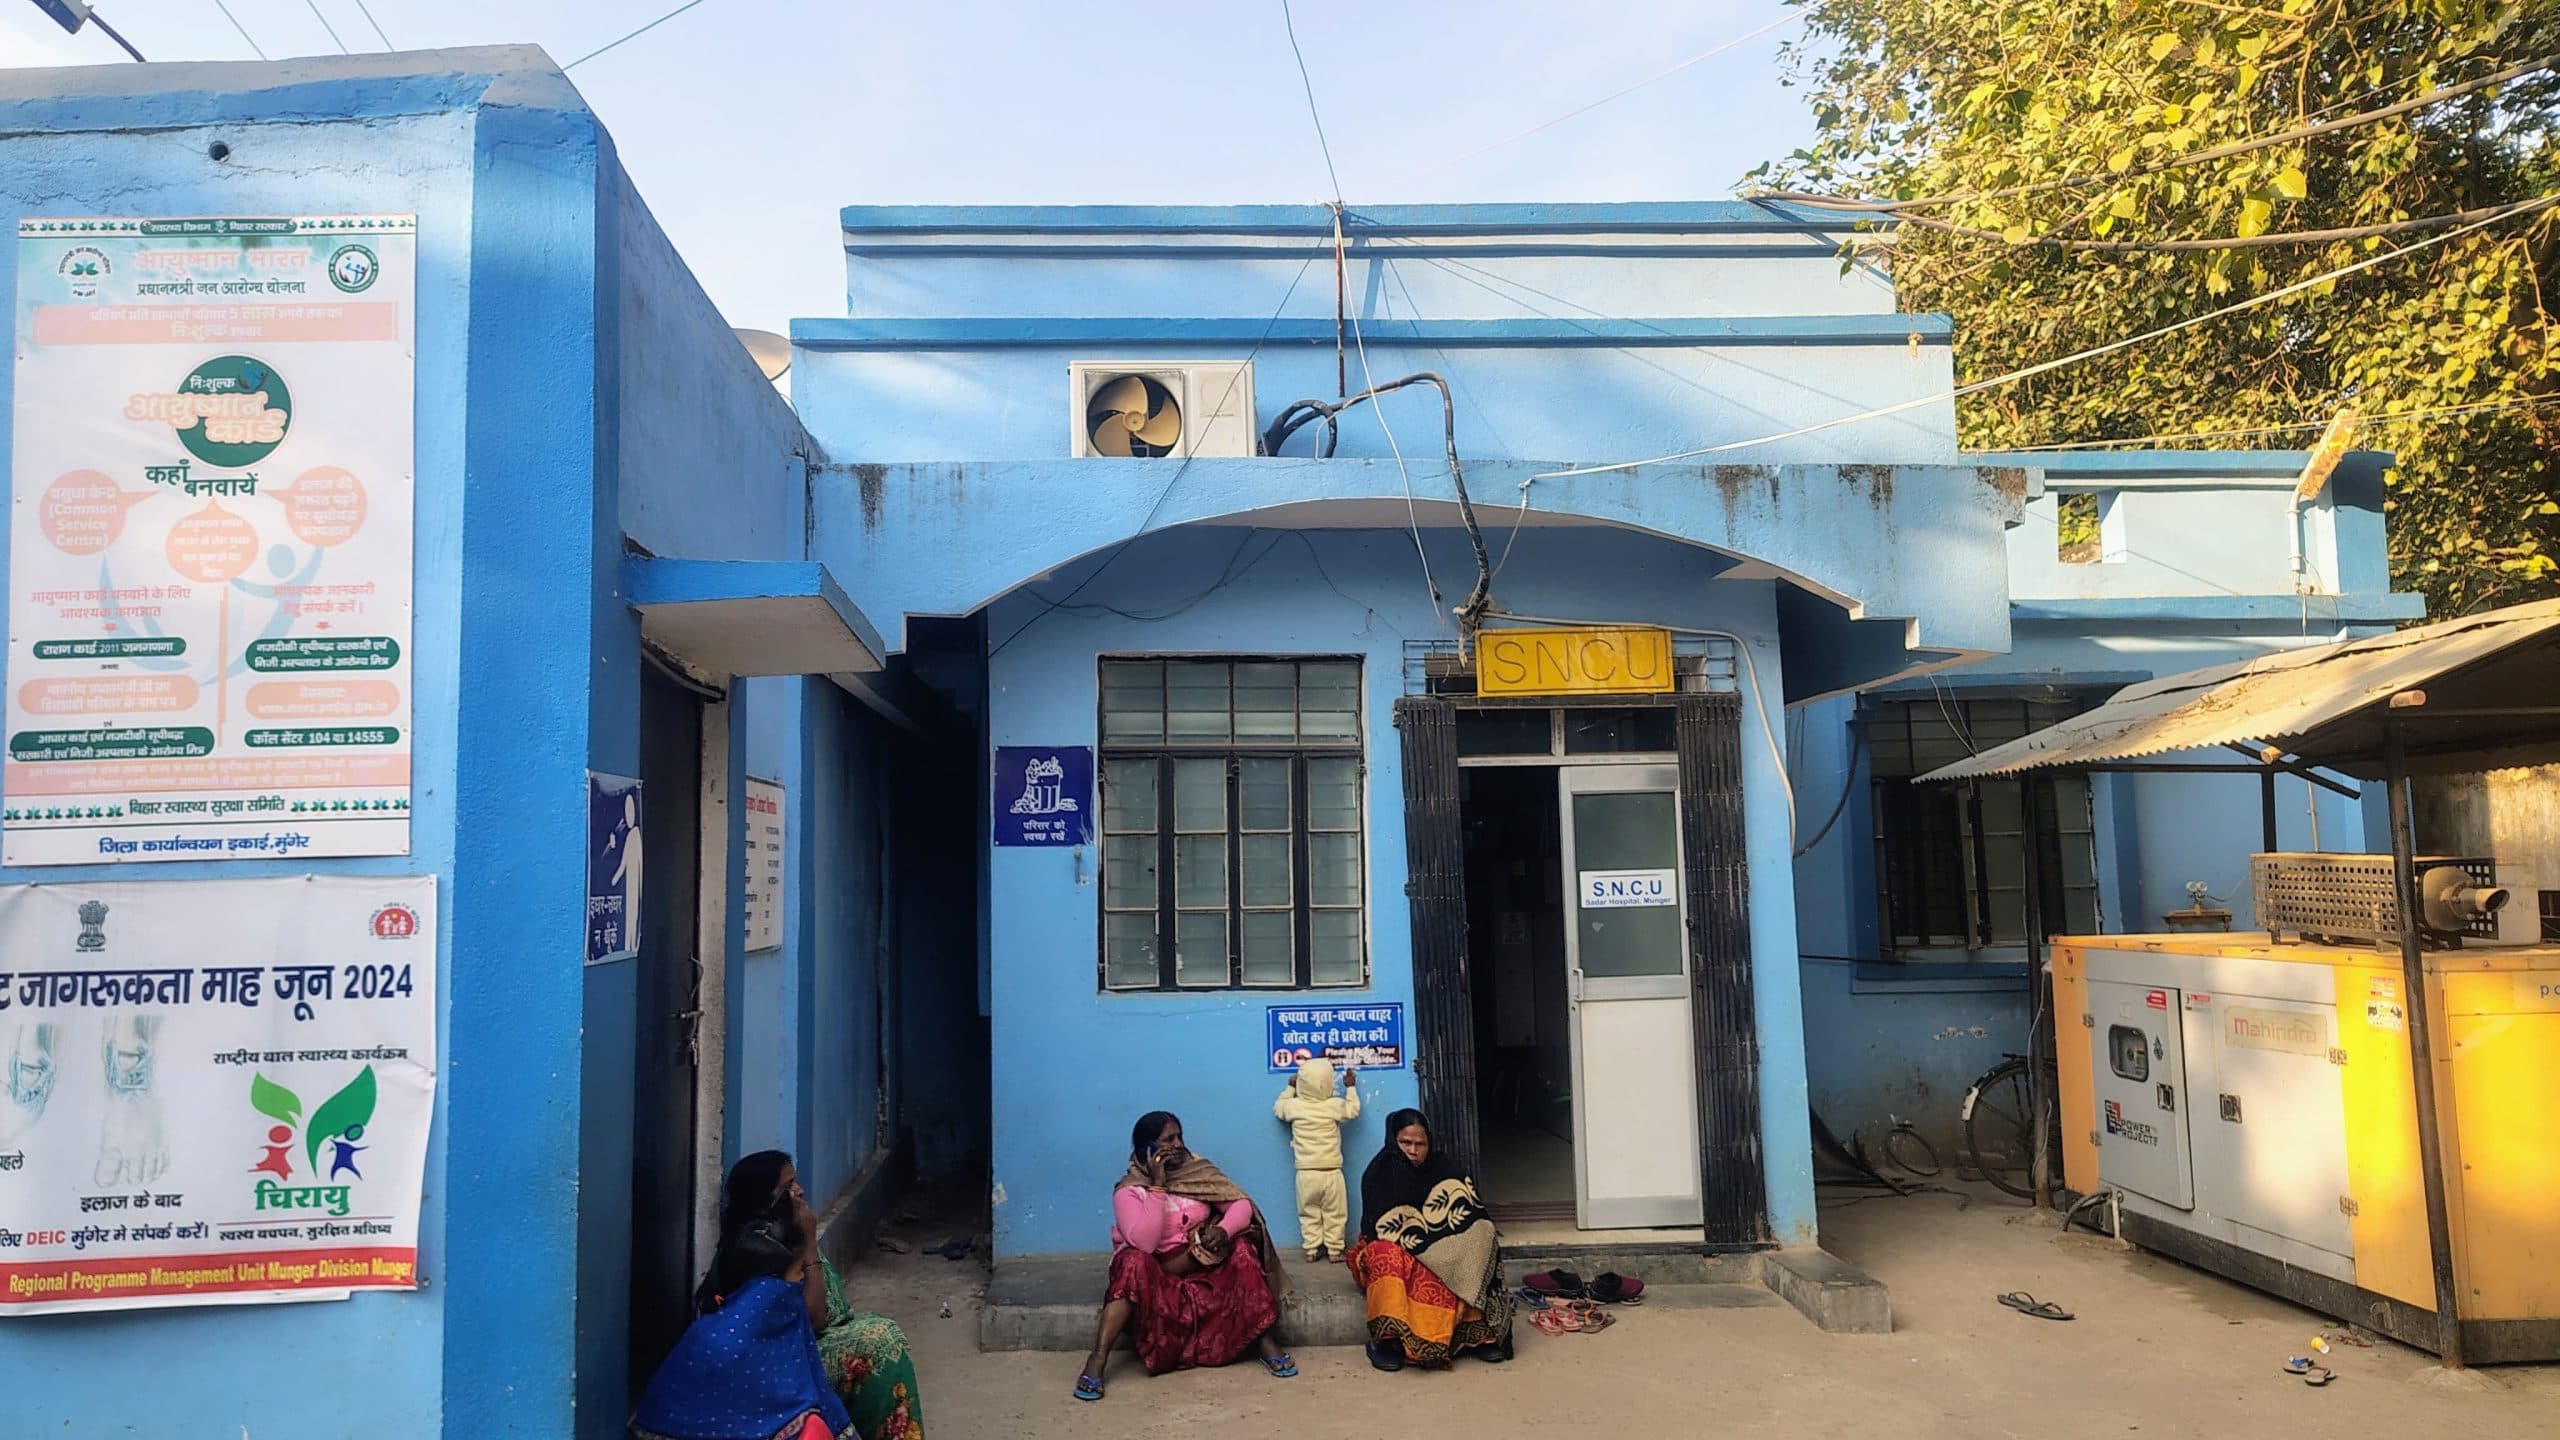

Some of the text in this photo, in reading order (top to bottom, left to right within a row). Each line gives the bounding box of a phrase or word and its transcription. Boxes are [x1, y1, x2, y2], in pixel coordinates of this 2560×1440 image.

[138, 247, 238, 275] आयुष्मान
[248, 246, 310, 269] भारत
[137, 278, 305, 297] प्रधानमंत्री जन आरोग्य योजना
[126, 392, 267, 427] आयुष्मान
[206, 408, 285, 442] कार्ड
[145, 459, 190, 485] कहाँ
[184, 474, 259, 497] बनवायें
[49, 504, 117, 518] (Common
[56, 518, 108, 530] Service
[32, 591, 79, 607] आयुष्मान
[84, 587, 109, 601] कार्ड
[152, 585, 164, 600] के
[167, 584, 192, 600] लिए
[60, 605, 112, 619] आवश्यक
[43, 641, 71, 656] राशन
[74, 638, 98, 654] कार्ड
[100, 642, 119, 654] 2011
[1493, 636, 1658, 685] SNCU
[38, 733, 66, 745] आधार
[253, 730, 278, 745] कॉल
[281, 729, 304, 743] सेंटर
[309, 732, 330, 744] 104
[348, 731, 384, 744] 14555
[17, 748, 52, 760] सरकारी
[69, 746, 94, 758] निजी
[129, 795, 285, 817] बिहार स्वास्थ्य सुरक्षा समिति
[1023, 818, 1066, 831] परिसर को
[99, 837, 138, 854] जिला
[142, 834, 222, 852] कार्यान्वयन
[1592, 879, 1662, 897] S.N.C.U
[1585, 898, 1607, 906] Sadar
[1643, 897, 1671, 905] Munger
[18, 967, 194, 1008] जागरूकता
[201, 966, 264, 1007] माह
[274, 965, 335, 1021] जून
[344, 964, 413, 1000] 2024
[1278, 1011, 1308, 1027] कृपया
[1367, 1008, 1392, 1023] बाहर
[1283, 1030, 1308, 1044] खोल
[1310, 1032, 1326, 1043] कर
[1328, 1028, 1339, 1045] ही
[1342, 1028, 1367, 1042] प्रवेश
[2233, 1017, 2317, 1043] Mahindra
[213, 1044, 408, 1066] राष्ट्रीय बाल स्वास्थ्य कार्यक्रम
[2120, 1118, 2151, 1133] POWER
[80, 1189, 184, 1213] इलाज के बाद
[254, 1180, 351, 1216] चिरायु
[27, 1230, 66, 1246] DEIC
[71, 1224, 111, 1250] मुंगेर
[131, 1222, 174, 1241] संपर्क
[219, 1229, 254, 1241] स्वस्थ
[306, 1222, 350, 1241] सुरक्षित
[353, 1221, 392, 1235] भविष्य
[9, 1257, 412, 1297] Regional Programme Management Unit Munger Division Munger
